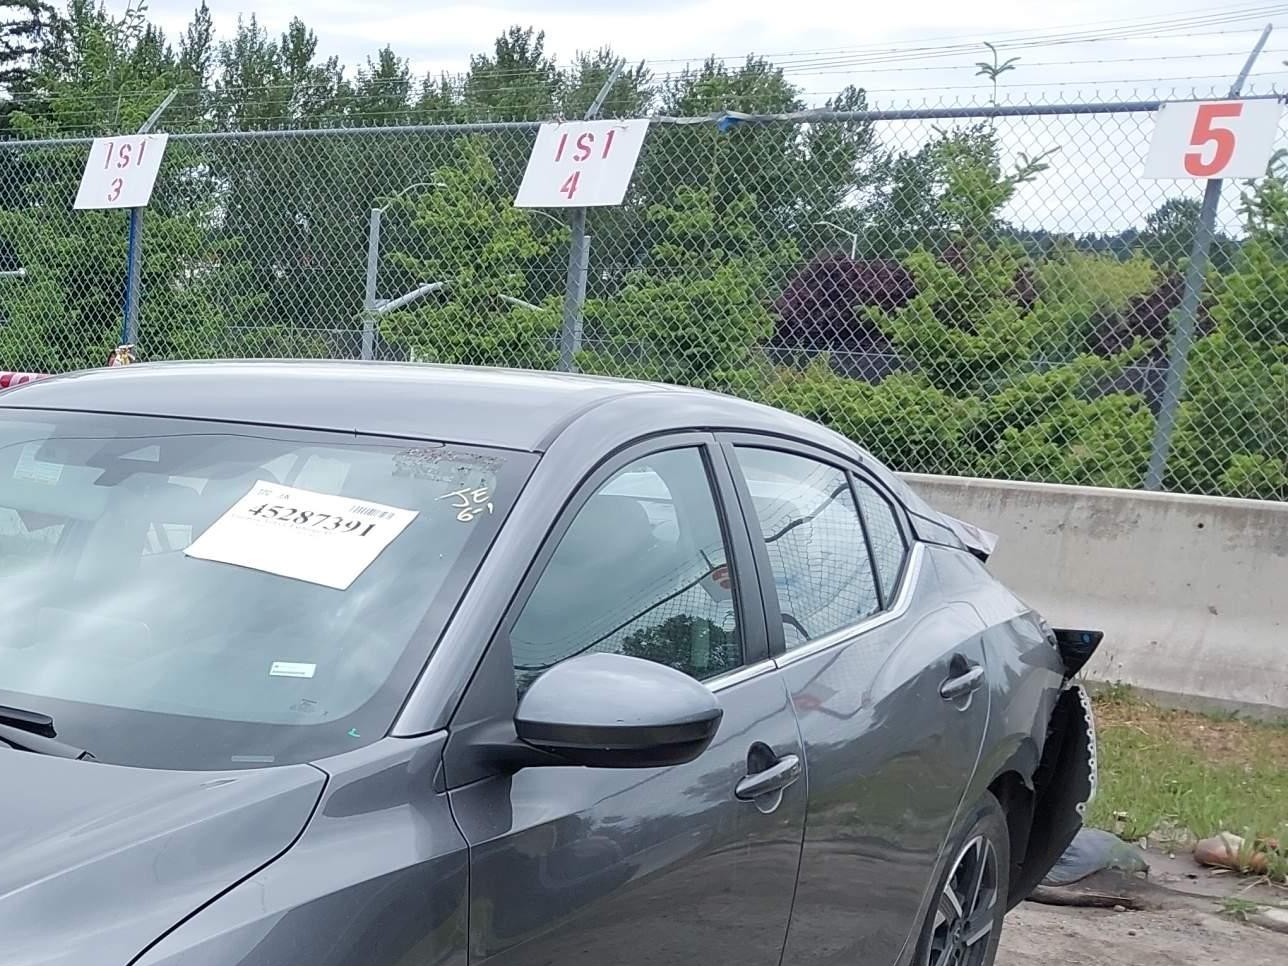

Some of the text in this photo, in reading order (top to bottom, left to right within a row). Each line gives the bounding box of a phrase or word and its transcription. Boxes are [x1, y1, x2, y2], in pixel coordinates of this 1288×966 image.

[1184, 102, 1243, 177] 5
[107, 177, 124, 202] 3
[559, 171, 581, 200] 4
[248, 502, 377, 538] 45287391
